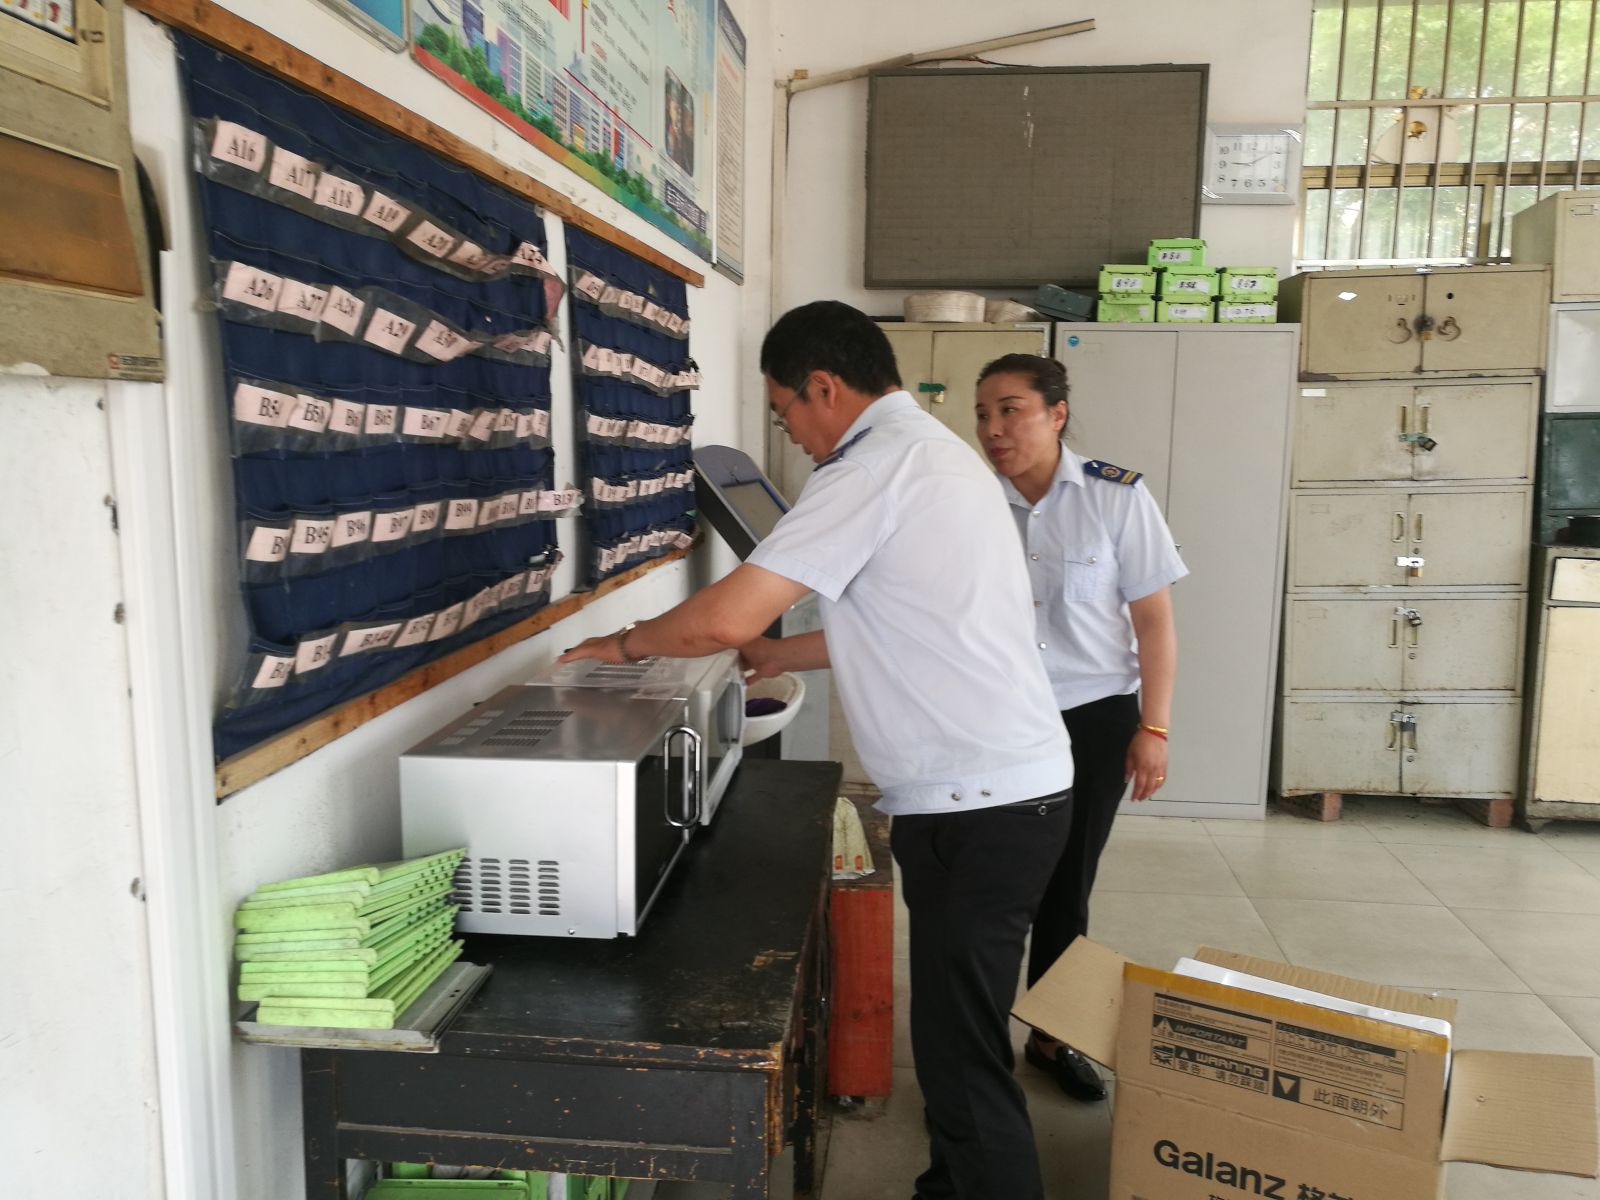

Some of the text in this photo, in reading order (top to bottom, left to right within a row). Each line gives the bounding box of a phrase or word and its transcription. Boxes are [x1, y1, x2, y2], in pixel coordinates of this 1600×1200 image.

[227, 135, 256, 163] A16
[286, 164, 312, 189] A17
[328, 186, 353, 209] A18
[243, 276, 275, 300] A26
[296, 290, 322, 314] A27
[1174, 1024, 1245, 1048] IMPORTANT
[1195, 1052, 1265, 1078] WARNING
[1313, 1087, 1388, 1120] 此面朝外
[1153, 1139, 1286, 1200] Galanz
